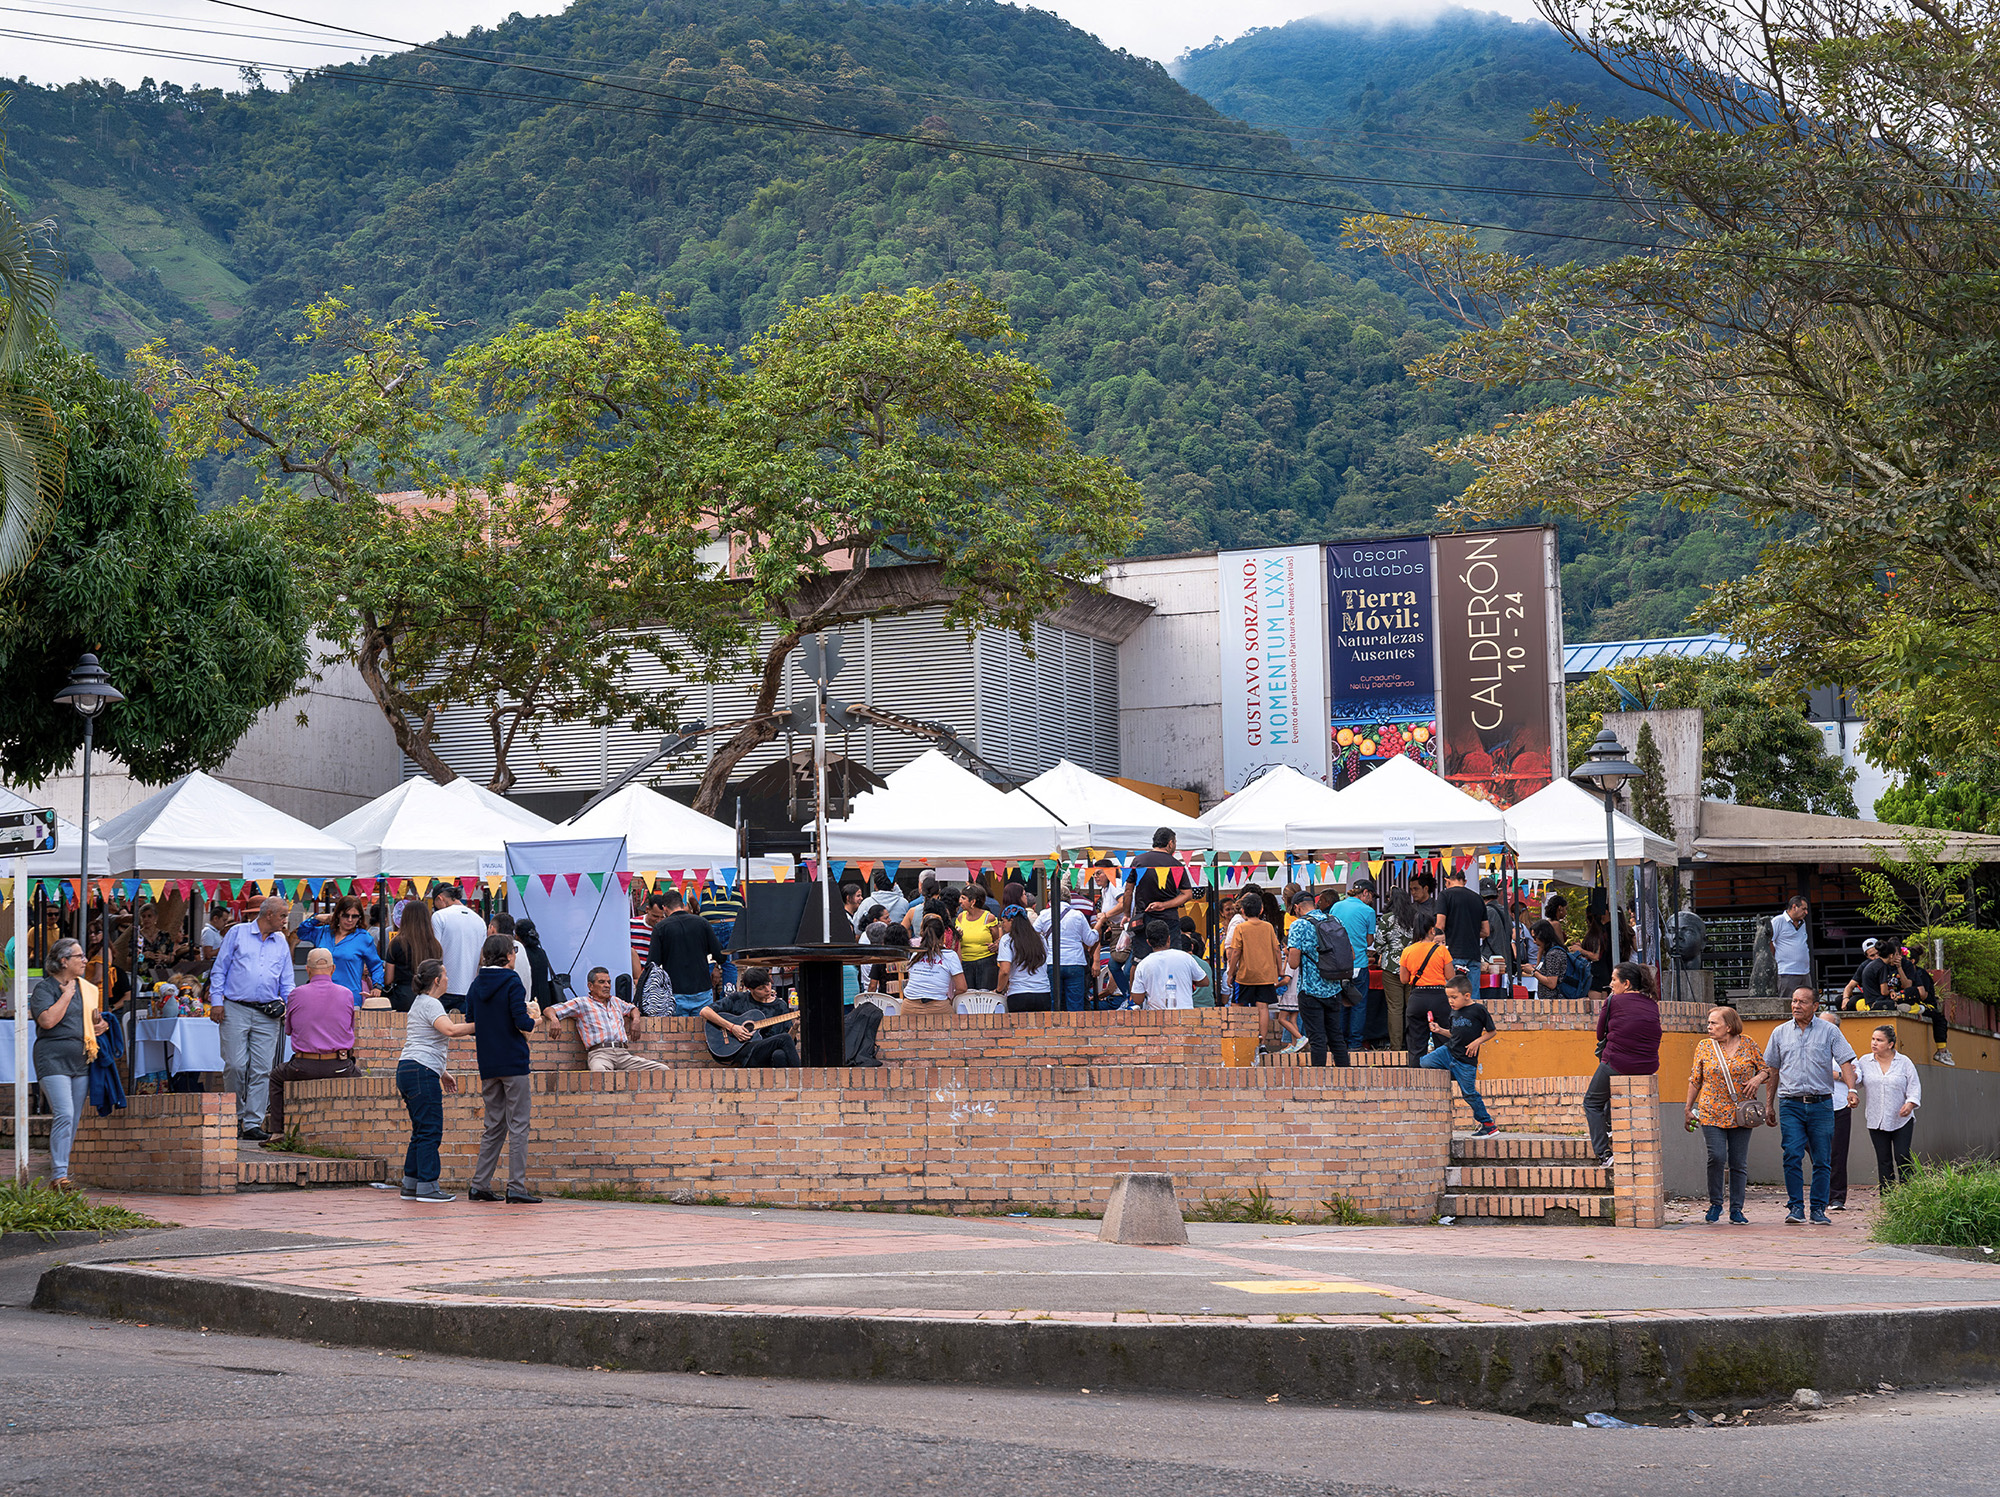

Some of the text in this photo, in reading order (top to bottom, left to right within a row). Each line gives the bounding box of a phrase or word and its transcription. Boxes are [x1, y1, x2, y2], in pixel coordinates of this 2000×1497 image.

[1353, 549, 1408, 563] Oscar
[1333, 563, 1425, 579] Villalobos
[1341, 589, 1418, 610] Tierra
[1504, 591, 1524, 619] 24
[1341, 608, 1420, 632] Móvil:
[1337, 631, 1424, 648] Naturalezas
[1459, 538, 1504, 730] CALDERÓN
[1243, 558, 1262, 746] GUSTAVO SORZANO:
[1264, 557, 1289, 745] MOMENTUM LXXX
[1285, 555, 1299, 744] Evento de participación [Partituras Mentales Varias]
[1351, 648, 1415, 662] Ausentes
[1507, 646, 1526, 673] 10
